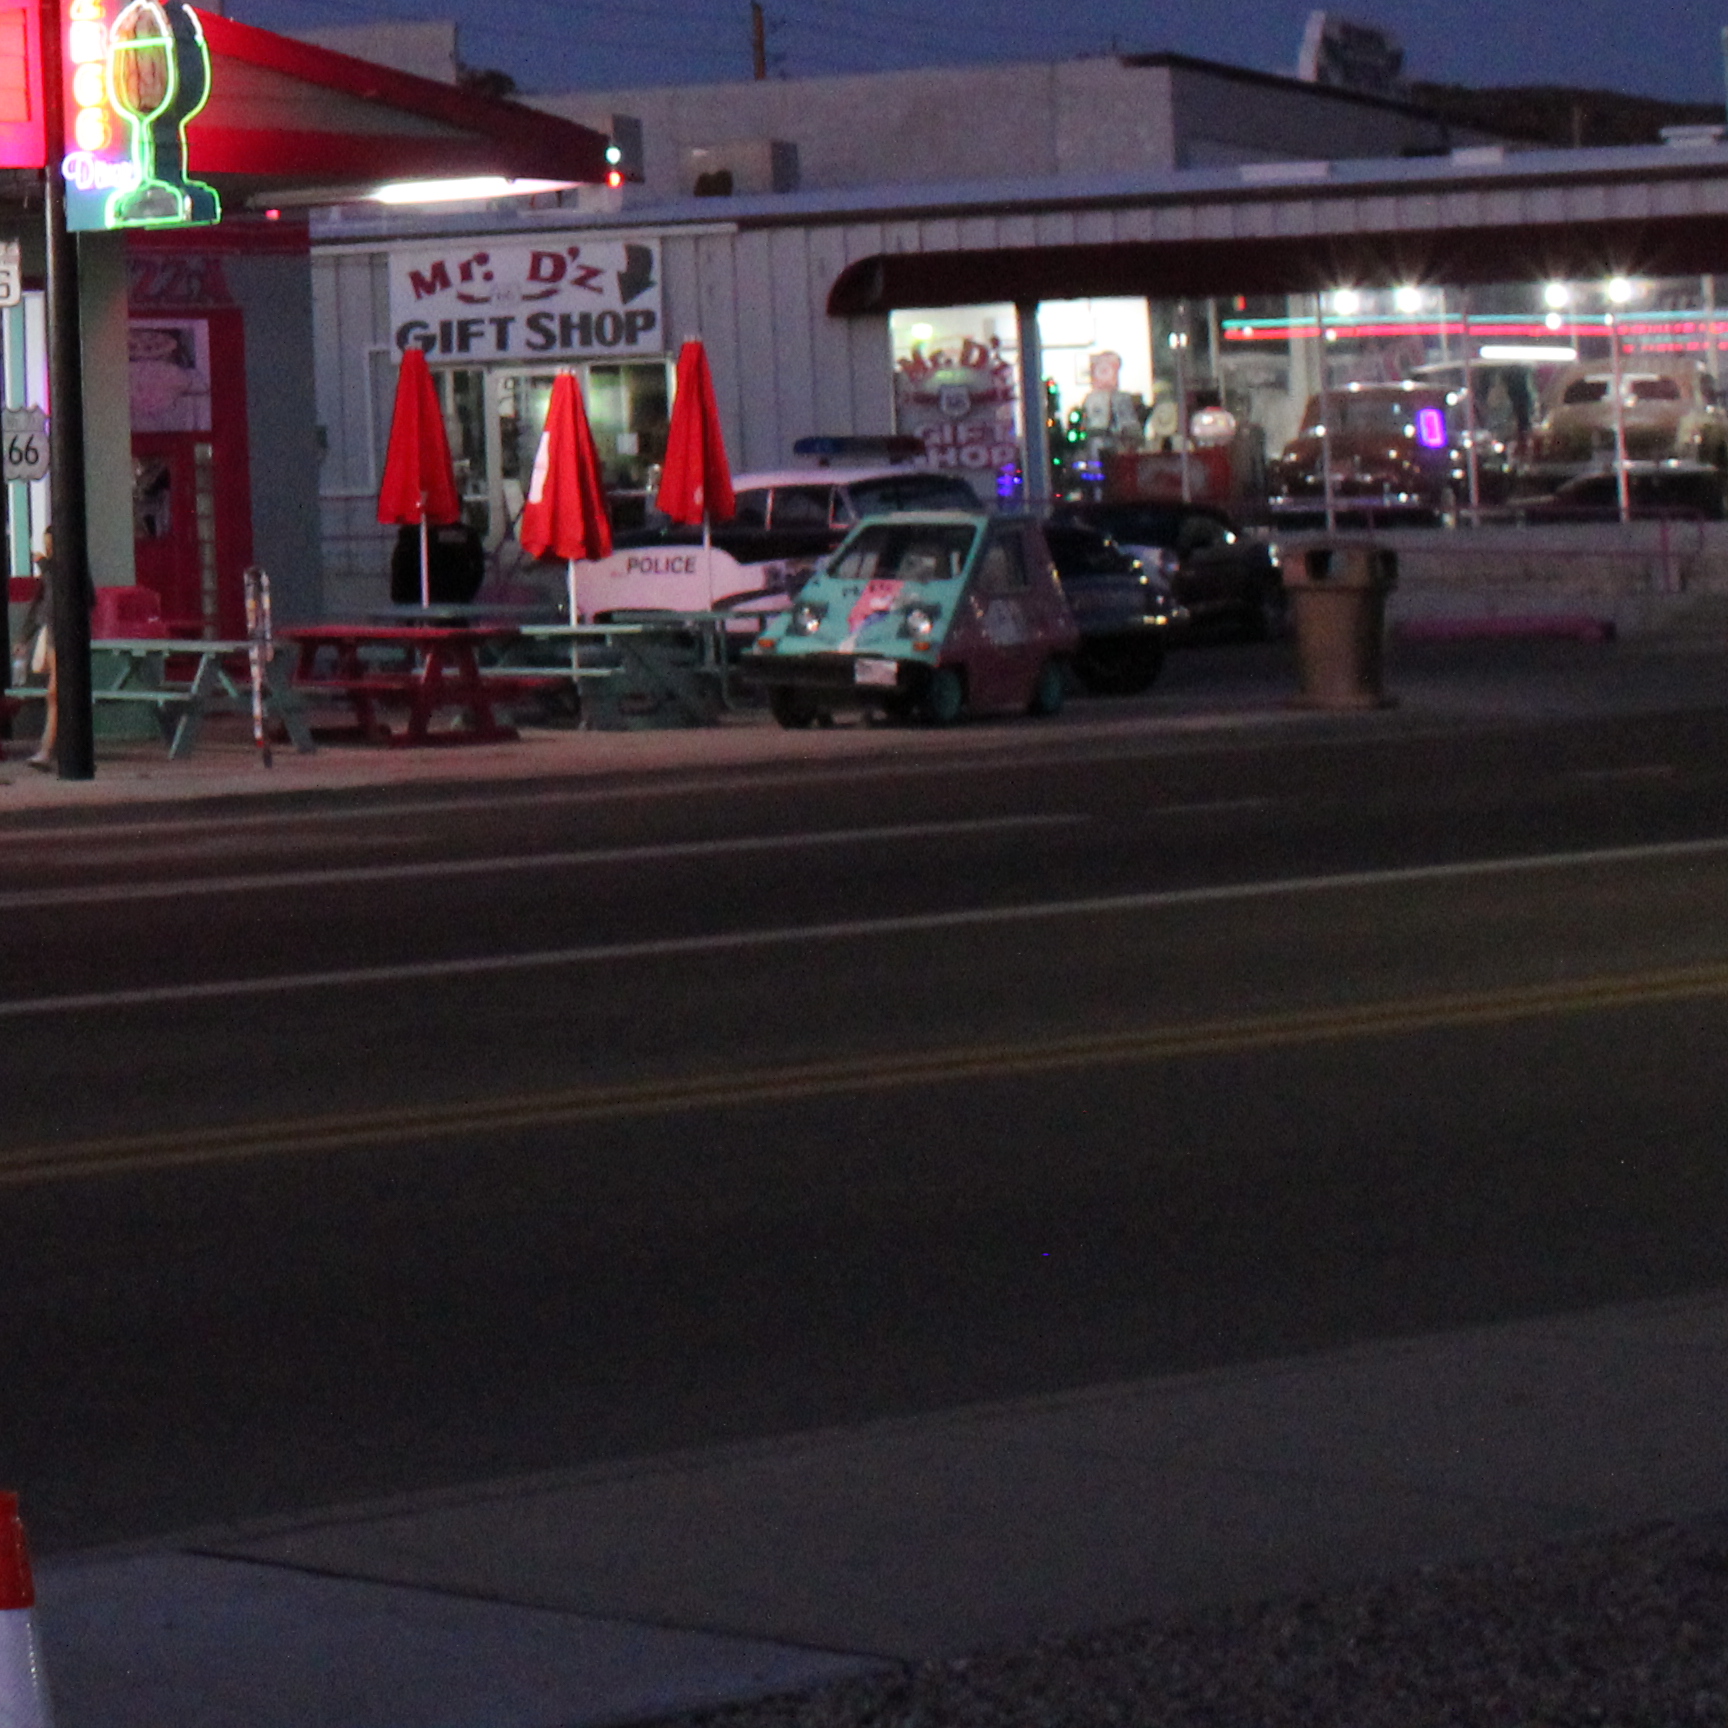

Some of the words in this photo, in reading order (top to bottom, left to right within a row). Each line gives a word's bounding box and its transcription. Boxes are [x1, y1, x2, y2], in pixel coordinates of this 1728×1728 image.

[408, 252, 494, 300] Mr.
[527, 246, 606, 294] D'z
[396, 315, 515, 354] GIFT
[525, 309, 657, 351] SHOP
[9, 433, 39, 466] 66
[626, 556, 696, 574] POLICE
